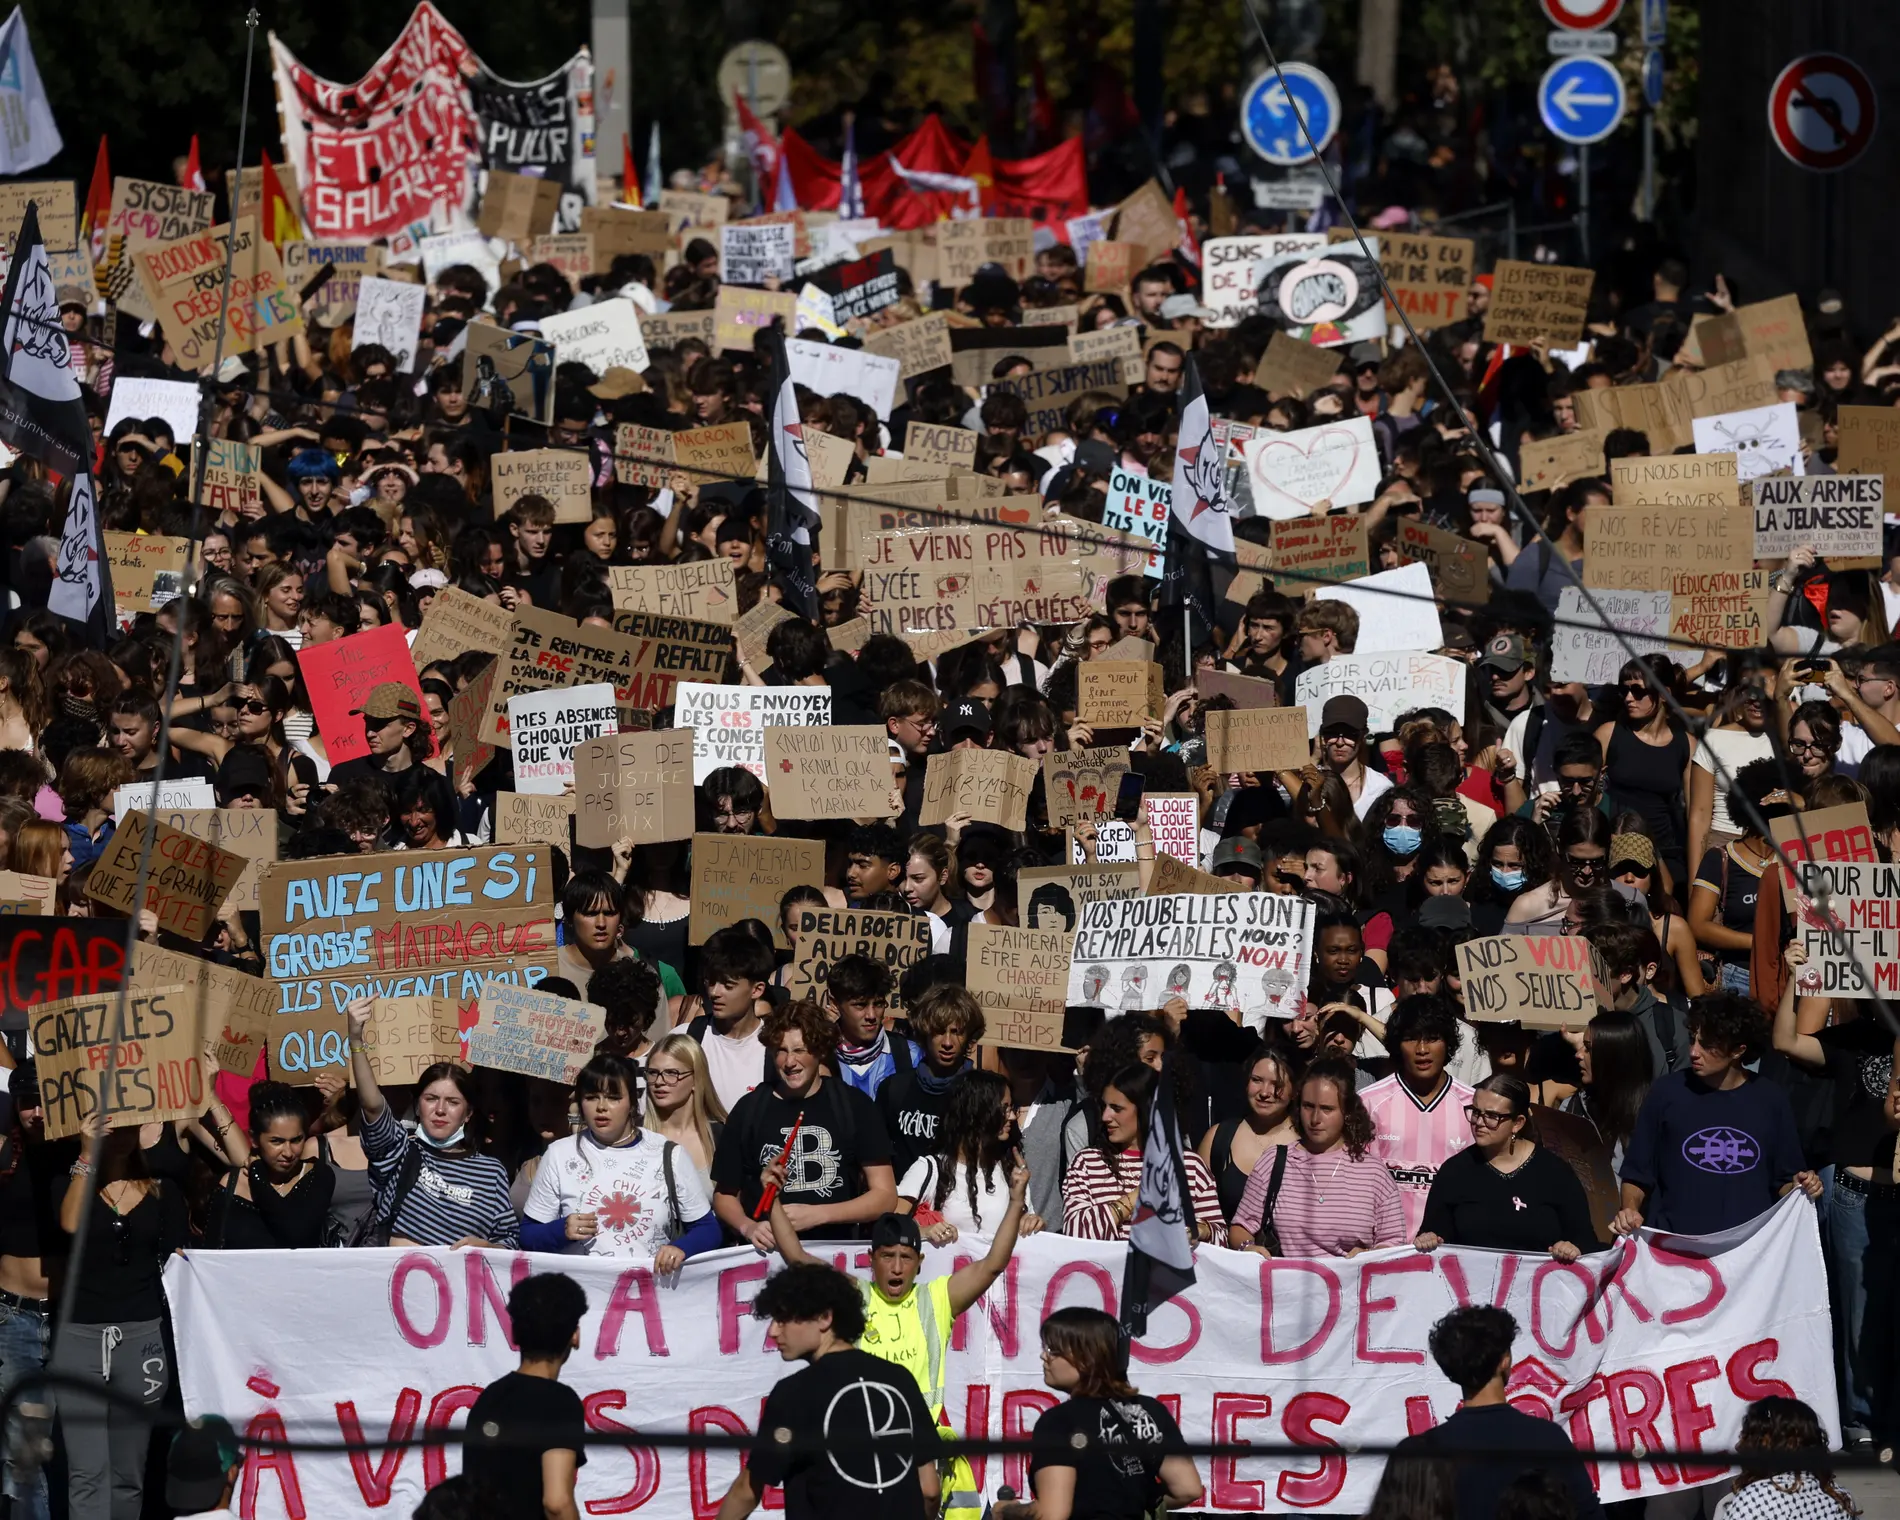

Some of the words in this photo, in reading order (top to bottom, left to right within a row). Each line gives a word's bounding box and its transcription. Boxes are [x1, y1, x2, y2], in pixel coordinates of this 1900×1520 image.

[1210, 245, 1262, 267] SENS
[1400, 243, 1428, 261] PAS
[1438, 245, 1462, 263] EU
[1212, 274, 1235, 290] DE
[673, 429, 735, 448] MACRON
[691, 450, 712, 461] PAS
[718, 448, 730, 458] DU
[498, 464, 514, 477] LA
[555, 460, 582, 471] NOUS
[1614, 467, 1638, 485] TU
[1644, 463, 1680, 483] NOUS
[1684, 462, 1702, 479] LA
[1705, 460, 1738, 478] METS
[234, 474, 256, 490] PAS
[565, 484, 587, 496] LES
[1113, 474, 1141, 495] ON
[1759, 481, 1803, 505] AUX
[1810, 478, 1882, 504] ARMES
[1124, 496, 1146, 517] LE
[1104, 511, 1133, 533] ILS
[1599, 517, 1626, 537] NOS
[1707, 516, 1729, 538] NE
[1756, 508, 1777, 532] LA
[1784, 506, 1875, 531] JEUNESSE
[144, 544, 166, 555] ans
[868, 537, 895, 564] JE
[909, 530, 973, 562] VIENS
[985, 530, 1026, 561] PAS
[1039, 525, 1068, 558] AU
[1400, 542, 1437, 560] VEUT
[1591, 541, 1656, 560] RENTRENT
[1665, 543, 1684, 560] PAS
[1697, 543, 1732, 561] DANS
[613, 571, 647, 592] LES
[656, 562, 735, 592] POUBELLES
[869, 567, 921, 603] LYCÉE
[1592, 571, 1615, 586] UNE
[1673, 571, 1740, 596] L'ÉDUCATION
[1743, 572, 1762, 589] EN
[659, 591, 700, 616] FAIT
[870, 608, 894, 636] EN
[976, 595, 1083, 628] DÉTACHÉES
[1673, 612, 1723, 635] ARRÊTEZ
[1726, 614, 1742, 630] DE
[1743, 613, 1761, 629] LA
[548, 636, 615, 665] RENTRE
[654, 643, 729, 673] REFAIT
[510, 647, 531, 663] LA
[537, 651, 574, 672] FAC
[578, 662, 631, 687] J'VIENS
[511, 664, 567, 685] D'AVOIR
[1297, 671, 1312, 688] LE
[1323, 663, 1362, 680] SOIR
[1369, 659, 1402, 678] ON
[1085, 674, 1099, 684] ne
[1107, 673, 1138, 684] veut
[1295, 686, 1319, 703] ON
[1412, 675, 1446, 693] PAS
[686, 691, 741, 711] VOUS
[516, 712, 547, 728] MES
[555, 706, 617, 725] ABSENCES
[682, 709, 714, 727] DES
[720, 711, 752, 728] CRS
[762, 712, 801, 727] MAIS
[806, 711, 830, 727] PAS
[1207, 711, 1250, 730] Quand
[517, 723, 602, 747] CHOQUENT
[831, 735, 850, 753] DU
[518, 746, 553, 764] QUE
[590, 744, 638, 769] PAS
[655, 742, 686, 766] DE
[1053, 752, 1069, 764] QUI
[1073, 750, 1088, 762] VA
[1090, 746, 1121, 762] NOUS
[598, 769, 686, 789] JUSTICE
[846, 760, 875, 778] QUE
[967, 763, 994, 774] EN
[802, 777, 818, 793] LE
[870, 777, 887, 791] DE
[927, 773, 1027, 804] LACRYMOTA
[129, 791, 194, 809] MACRON
[537, 803, 568, 819] VOUS
[585, 792, 614, 813] PAS
[635, 792, 655, 807] DE
[810, 793, 868, 816] MARINE
[959, 793, 998, 808] CIE
[1059, 814, 1075, 828] DE
[160, 834, 236, 879] COLÈRE
[706, 839, 812, 873] J'AIMERAIS
[158, 866, 227, 908] GRANDE
[704, 867, 736, 885] ÊTRE
[749, 872, 784, 886] AUSSI
[1070, 874, 1093, 889] YOU
[1098, 874, 1123, 887] SAY
[1803, 863, 1861, 897] POUR
[285, 872, 383, 923] AVEC
[394, 857, 477, 912] UNE
[1079, 889, 1103, 905] YOU
[89, 870, 118, 901] QUE
[145, 886, 207, 934] BITE
[701, 901, 729, 917] MON
[1083, 901, 1116, 930] VOS
[1119, 895, 1240, 928] POUBELLES
[1246, 894, 1308, 930] SONT
[269, 926, 373, 979] GROSSE
[374, 919, 552, 970] MATRAQUE
[986, 929, 1074, 955] J'AIMERAIS
[1805, 930, 1888, 957] FAUT-IL
[981, 947, 1021, 969] ÊTRE
[1464, 937, 1518, 973] NOS
[1524, 935, 1592, 972] VOIX
[138, 950, 187, 981] VIENS
[1824, 961, 1864, 992] DES
[277, 980, 323, 1014] ILS
[329, 970, 459, 1015] DOIVENT
[486, 985, 567, 1017] DONNEZ
[970, 990, 1011, 1009] MON
[1013, 986, 1042, 1000] QUE
[1466, 974, 1508, 1014] NOS
[1515, 972, 1584, 1012] SEULES
[416, 998, 443, 1020] NE
[1013, 1012, 1032, 1025] DU
[33, 1003, 112, 1057] GAZEZ
[119, 995, 175, 1043] LES
[494, 1005, 520, 1024] DE
[528, 1012, 597, 1038] MOYENS
[407, 1024, 461, 1045] FEREZ
[497, 1022, 534, 1044] AUX
[996, 1023, 1055, 1046] TEMPS
[549, 1050, 569, 1068] NE
[42, 1067, 98, 1128] PAS
[98, 1067, 156, 1115] LES
[157, 1056, 205, 1111] ADO
[1377, 1134, 1401, 1142] adidas
[613, 1179, 646, 1198] CHILI
[388, 1251, 533, 1351] ON
[594, 1266, 670, 1361] A
[238, 1366, 307, 1520] À
